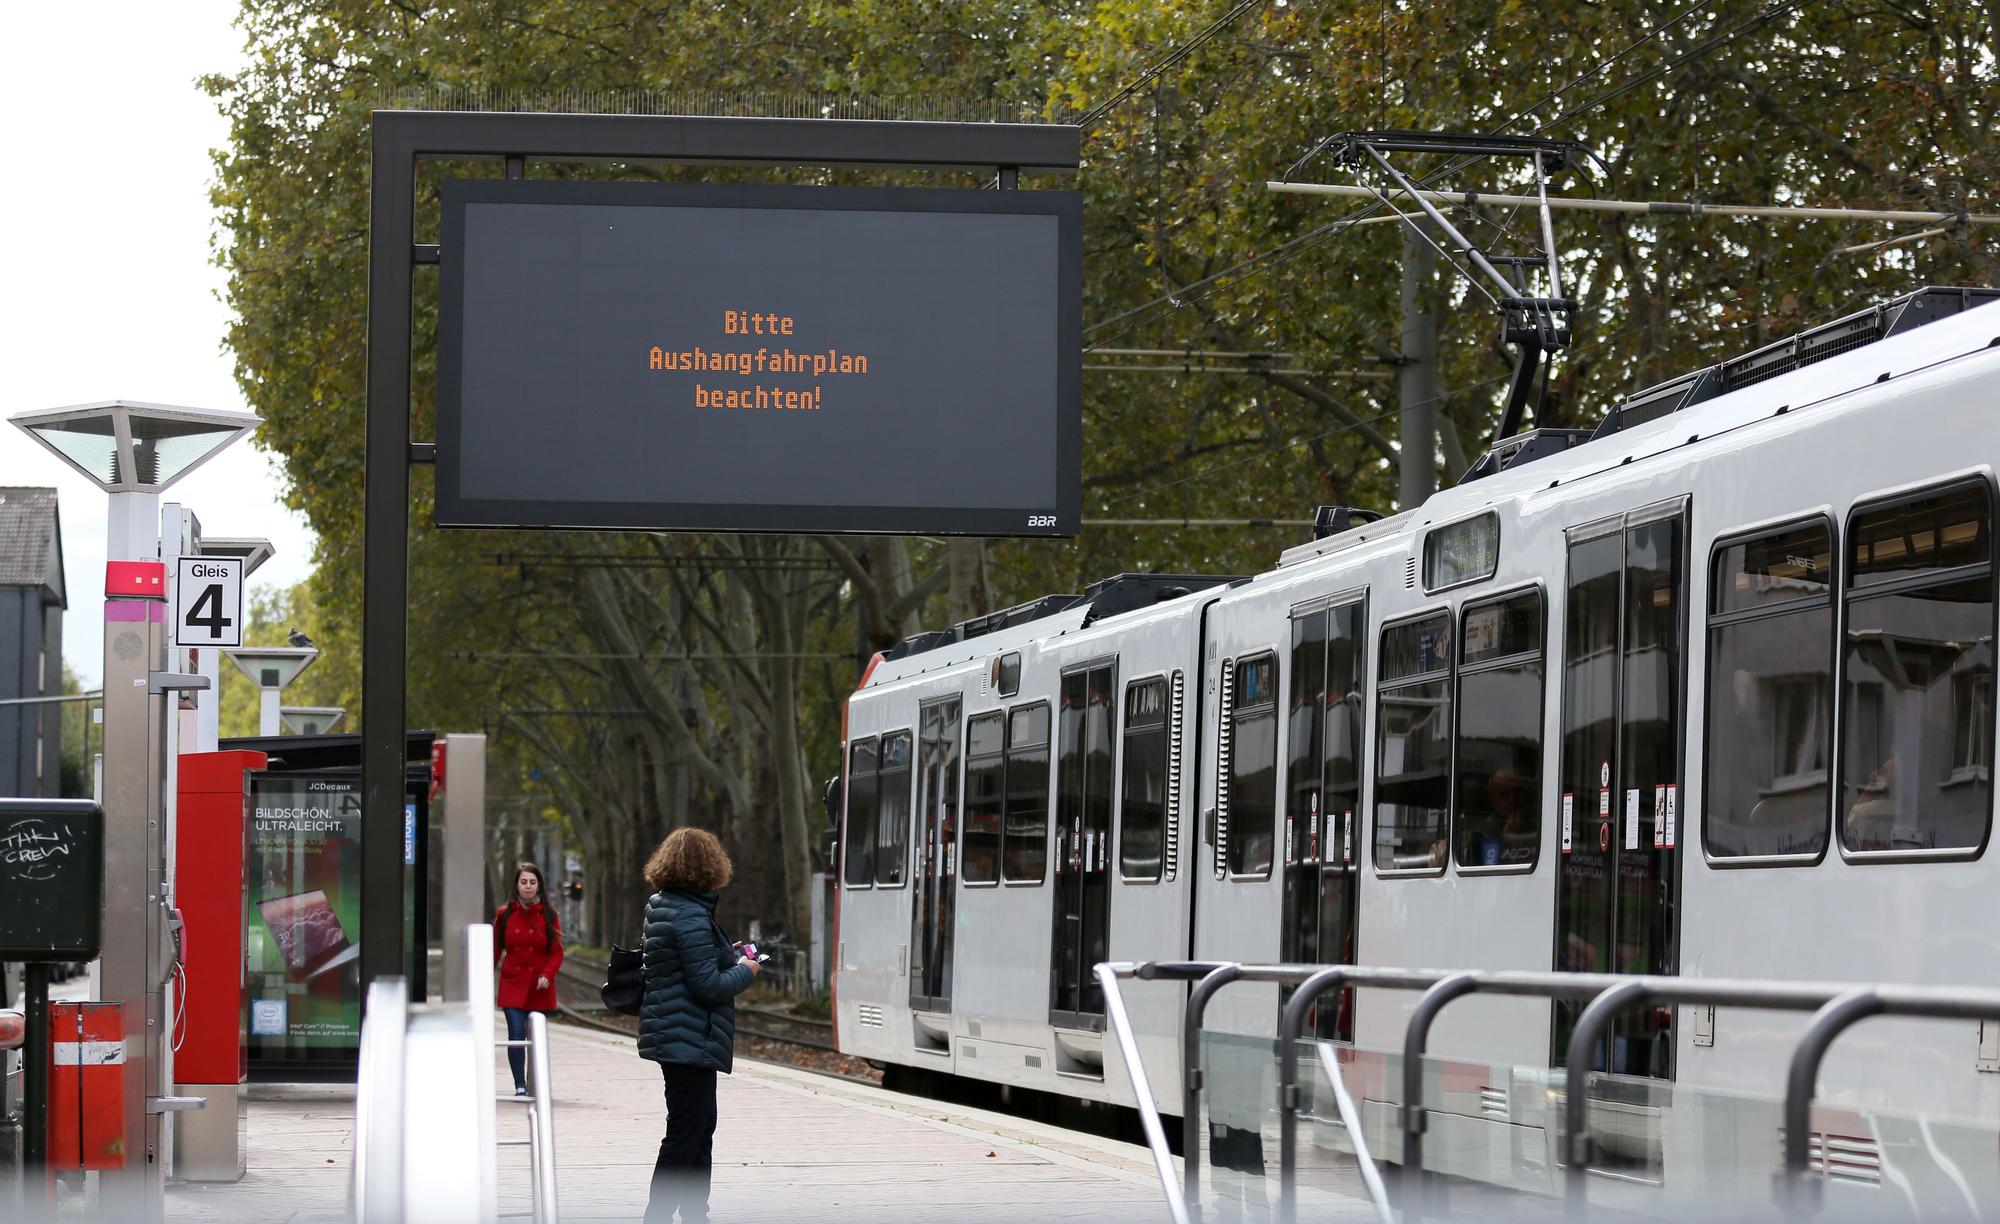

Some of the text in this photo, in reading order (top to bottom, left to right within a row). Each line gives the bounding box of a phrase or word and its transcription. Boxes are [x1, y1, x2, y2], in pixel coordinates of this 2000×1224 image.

[725, 310, 794, 335] Bitte
[649, 345, 868, 376] Aushangfahrplan
[695, 383, 822, 410] beachten!
[1027, 515, 1057, 527] BBR
[191, 563, 229, 578] Gleis
[185, 583, 232, 639] 4
[308, 782, 351, 791] JCDecaux
[255, 806, 332, 819] BILDSCHÖN.
[255, 820, 343, 832] ULTRALEICHT.
